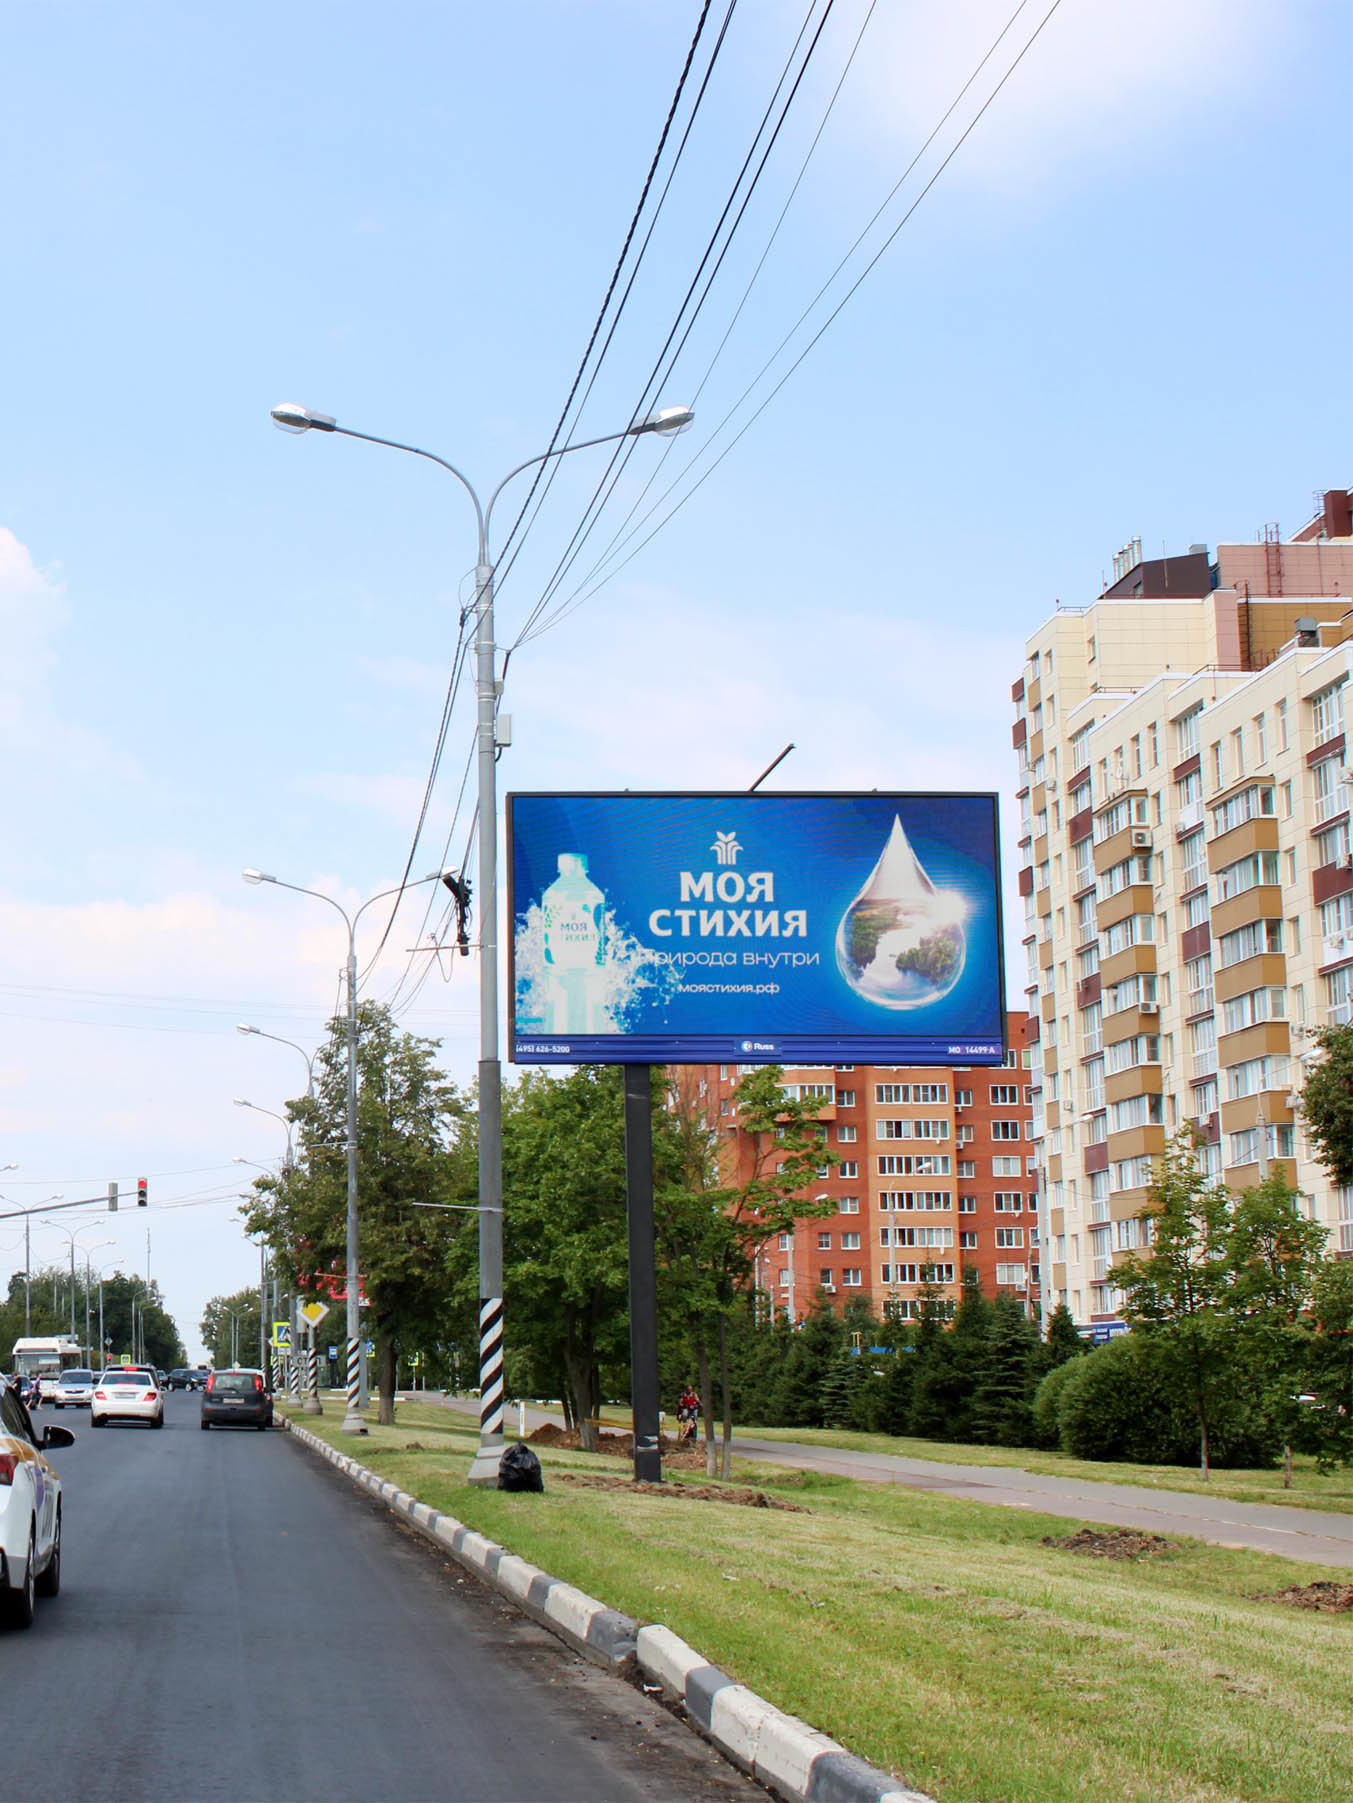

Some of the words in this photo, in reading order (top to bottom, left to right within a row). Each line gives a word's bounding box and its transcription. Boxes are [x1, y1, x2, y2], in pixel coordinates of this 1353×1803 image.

[680, 871, 774, 903] МОЯ
[649, 909, 807, 937] СТИХИЯ
[743, 952, 820, 968] внутри
[679, 983, 780, 995] моястихия.рф
[753, 1042, 774, 1050] Russ
[297, 1357, 321, 1365] СТП
